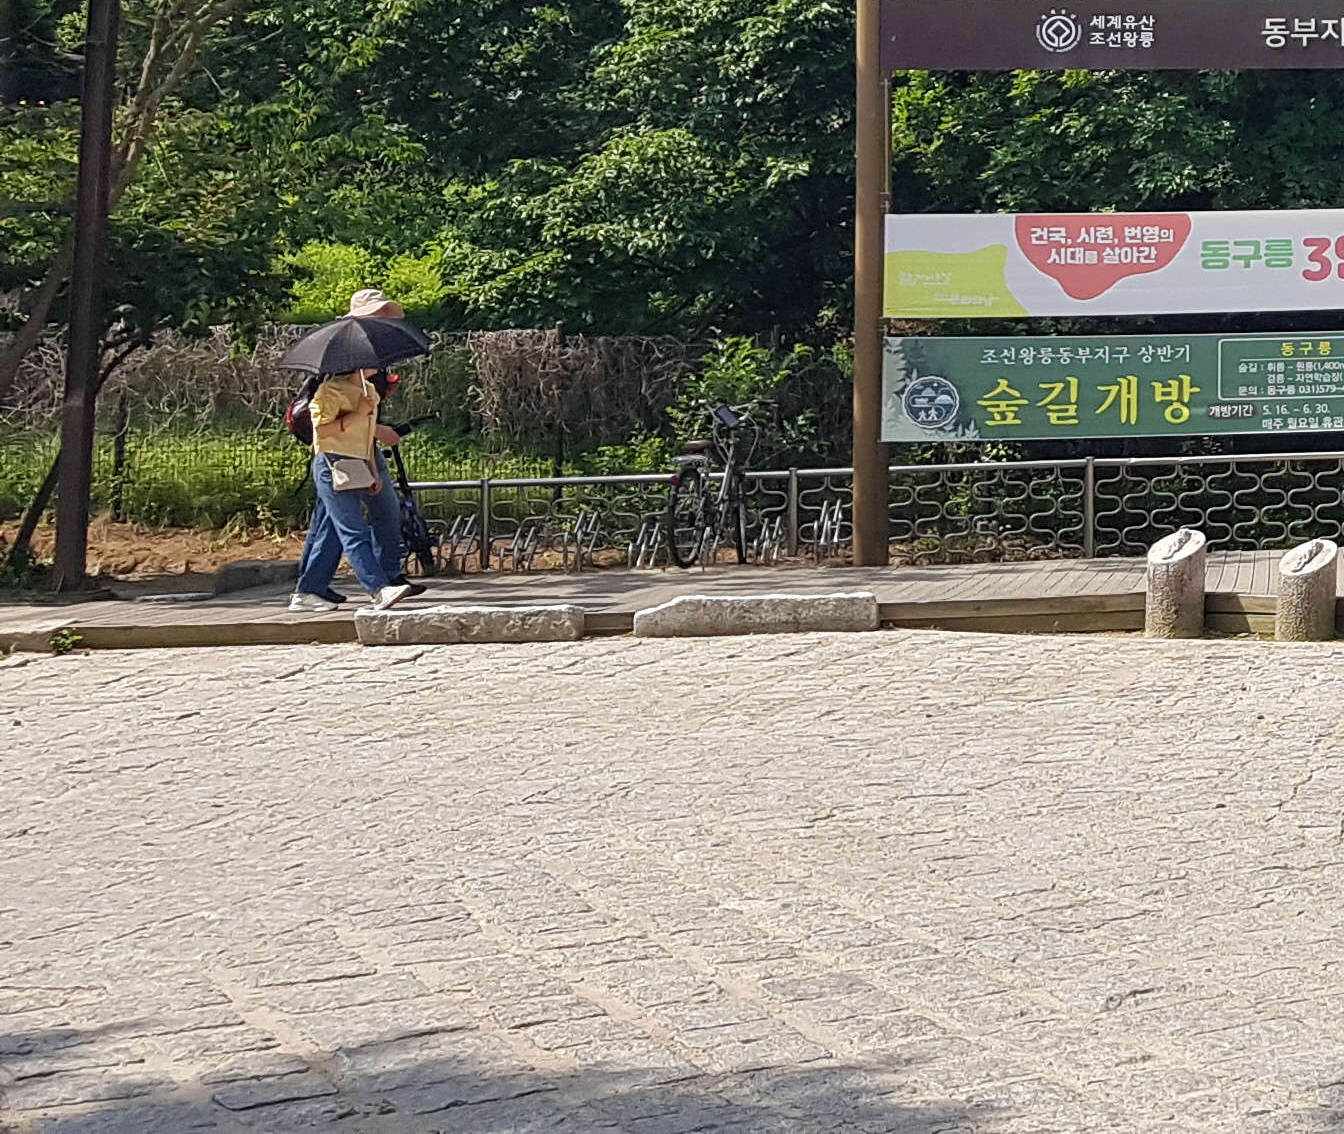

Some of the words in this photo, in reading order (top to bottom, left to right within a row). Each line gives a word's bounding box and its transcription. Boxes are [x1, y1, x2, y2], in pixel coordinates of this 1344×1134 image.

[1089, 14, 1155, 30] 세계유산
[1088, 31, 1155, 48] 조선왕릉
[1030, 226, 1072, 245] 건국,
[1077, 226, 1118, 245] 시련,
[1124, 225, 1174, 244] 번영의
[1046, 247, 1097, 265] 시대를
[1102, 246, 1157, 264] 살아간
[1200, 239, 1294, 270] 동구릉
[980, 346, 1130, 365] 조선왕릉동부지구
[1138, 344, 1190, 363] 상반기
[1238, 385, 1257, 395] 문의
[1209, 404, 1254, 417] 개방기간
[1262, 418, 1284, 430] 매주
[1287, 417, 1319, 429] 월요일
[1322, 416, 1344, 428] 휴관
